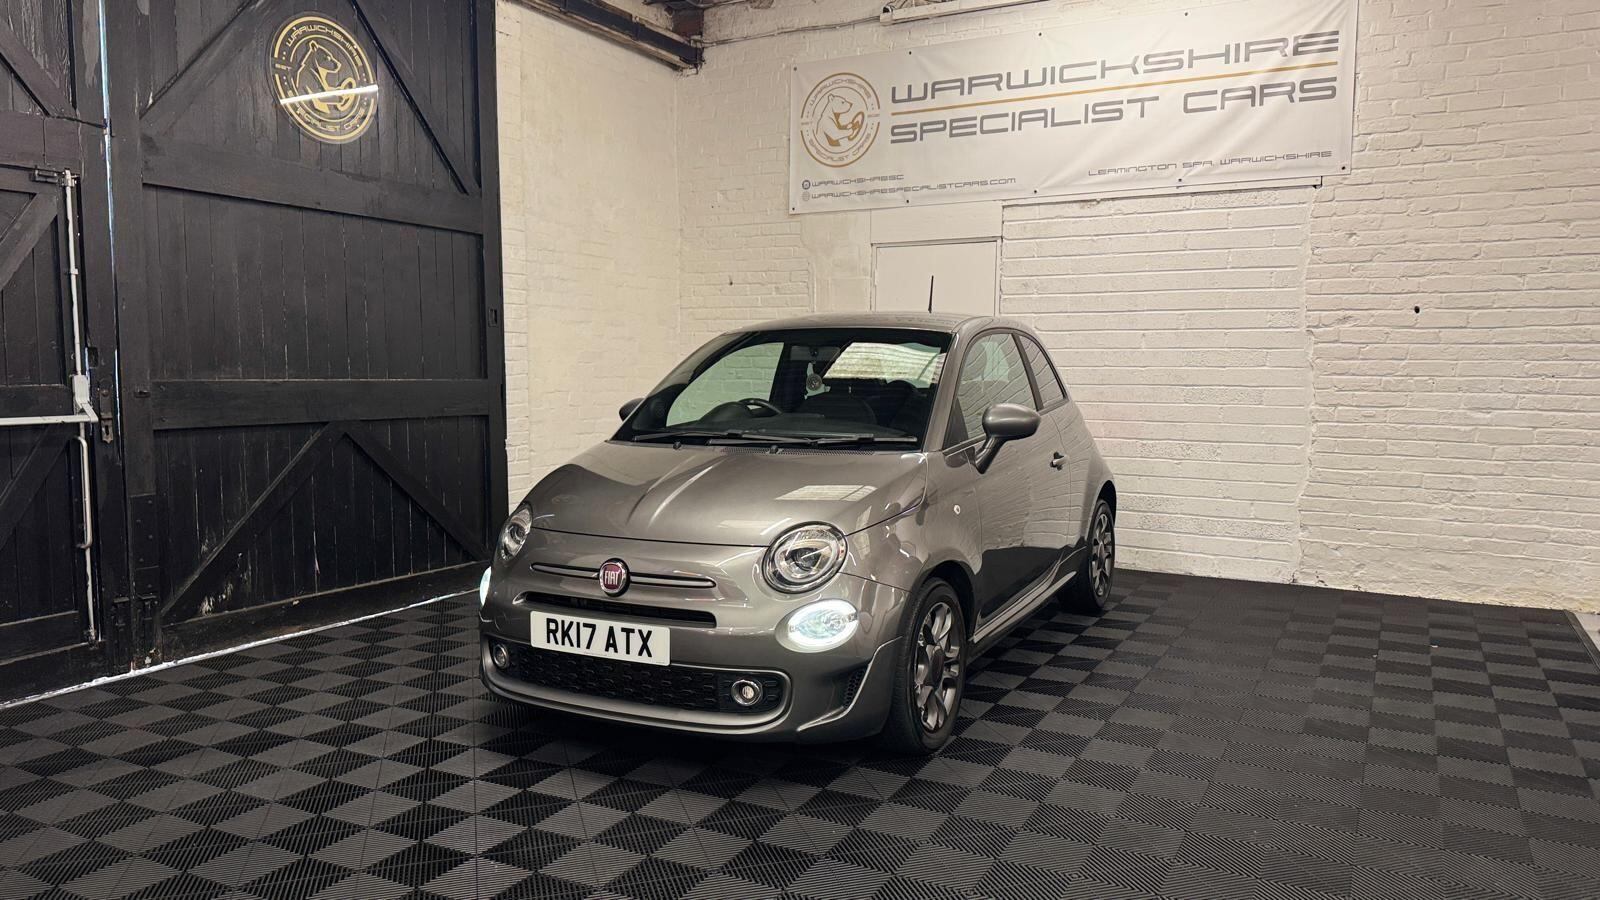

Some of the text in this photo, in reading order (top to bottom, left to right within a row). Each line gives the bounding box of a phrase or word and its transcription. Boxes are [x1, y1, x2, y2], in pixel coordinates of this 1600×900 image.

[890, 30, 1340, 104] WARWICKSHIRE
[889, 77, 1338, 145] SPECIALIST CARS
[1088, 163, 1177, 176] LEAMINGTON
[1220, 150, 1333, 165] WARWICKSHIRE
[604, 570, 621, 586] FIAT
[546, 617, 653, 658] RK17 ATX
